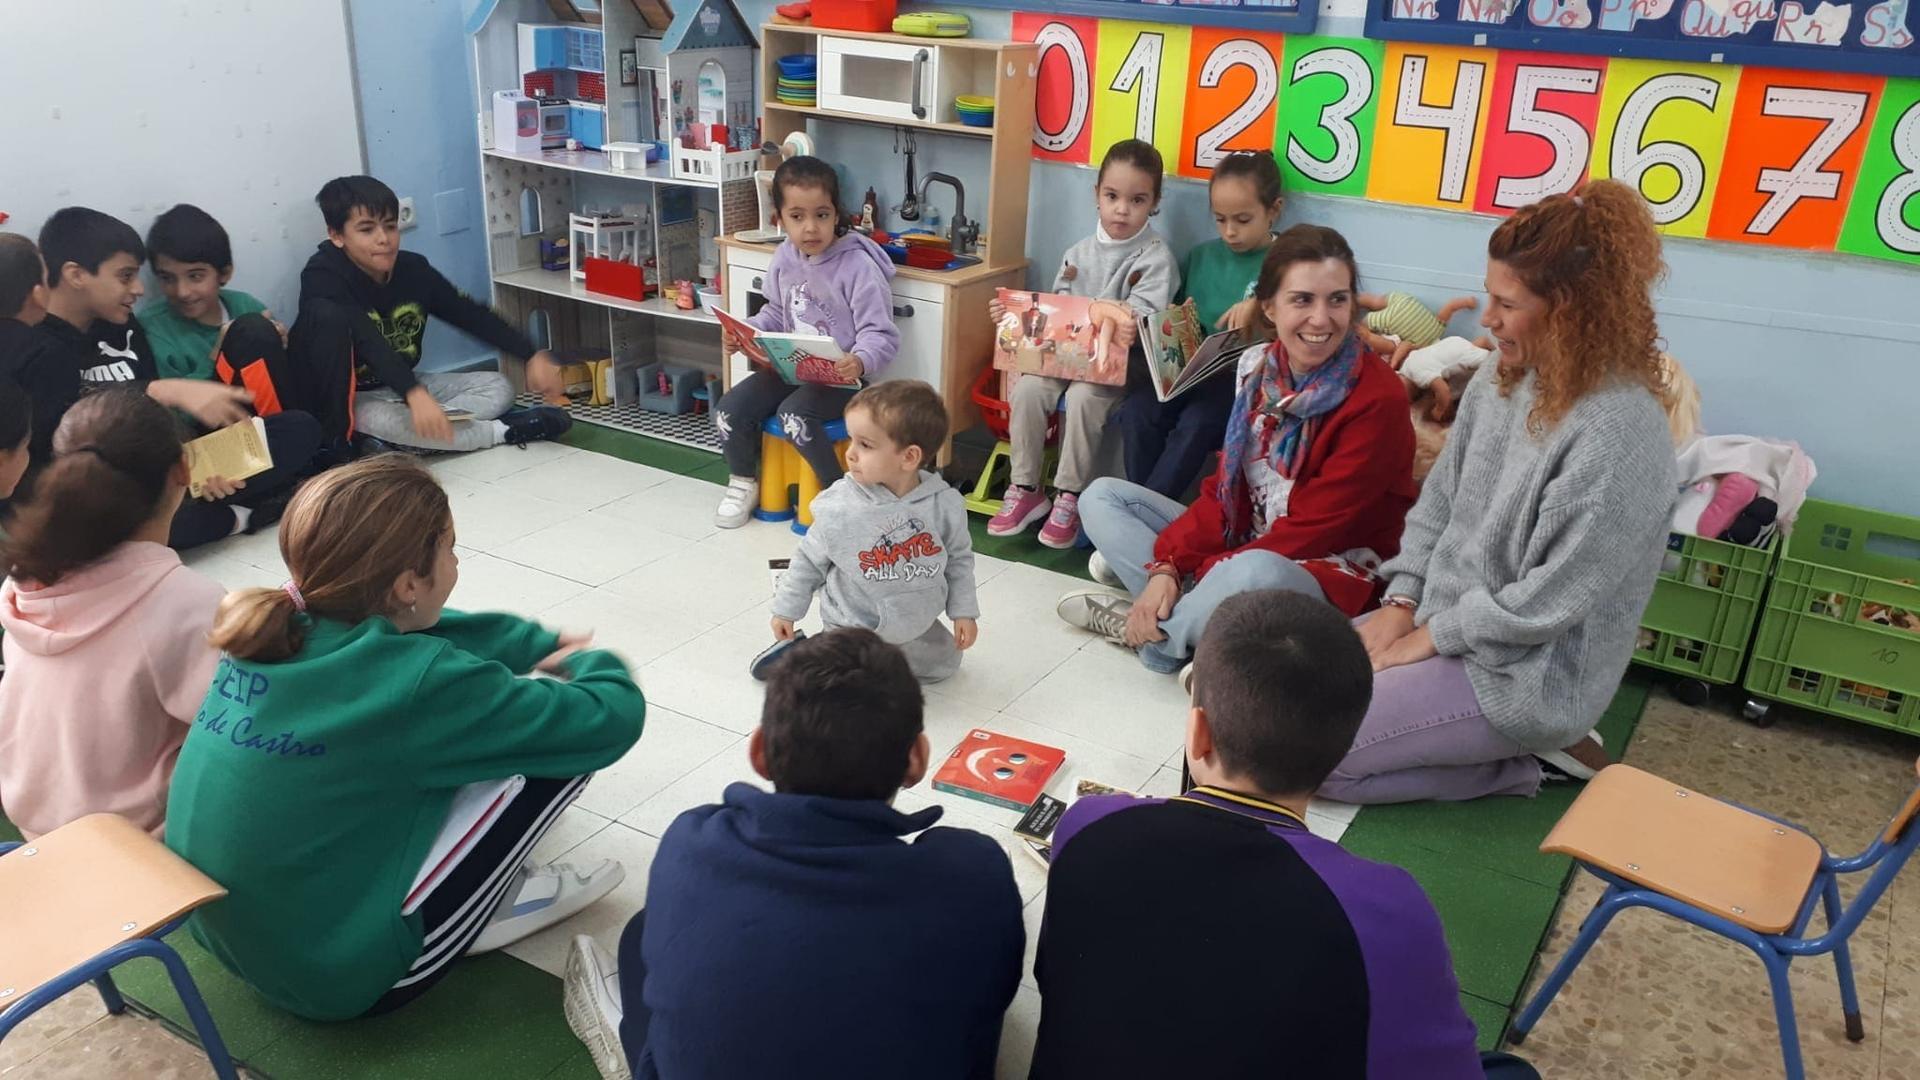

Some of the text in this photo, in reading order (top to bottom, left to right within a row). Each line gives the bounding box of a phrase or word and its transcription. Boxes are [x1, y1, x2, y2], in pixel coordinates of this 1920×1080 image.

[1776, 2, 1826, 43] Rr
[1862, 6, 1913, 47] Ss
[1032, 21, 1090, 152] 0
[1109, 31, 1165, 146] 1
[1194, 38, 1279, 168] 2
[1286, 47, 1374, 184] 3
[1392, 54, 1486, 203] 4
[1492, 64, 1602, 208] 5
[1609, 72, 1721, 225] 6
[1743, 85, 1872, 235] 7
[858, 532, 942, 573] SKATE
[864, 566, 900, 581] ALL
[205, 708, 228, 735] de
[231, 716, 326, 756] Castro
